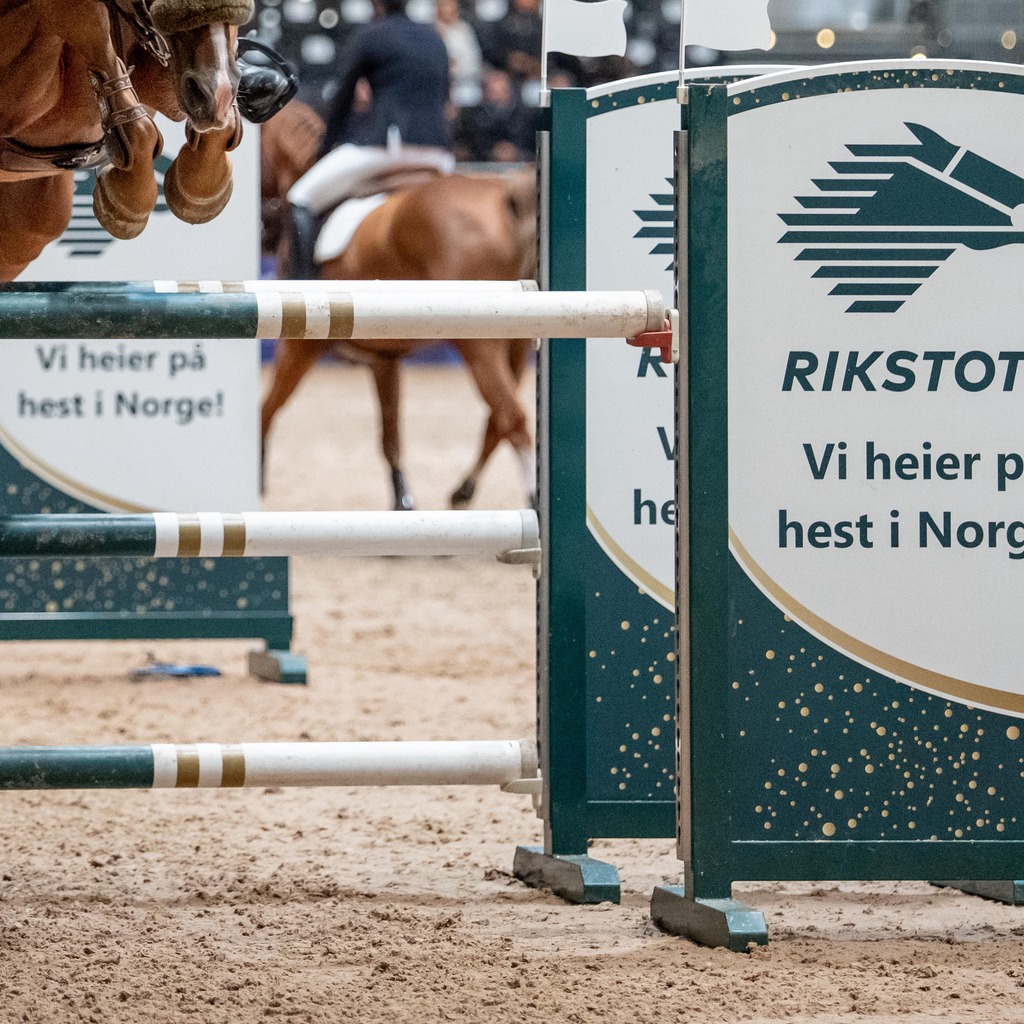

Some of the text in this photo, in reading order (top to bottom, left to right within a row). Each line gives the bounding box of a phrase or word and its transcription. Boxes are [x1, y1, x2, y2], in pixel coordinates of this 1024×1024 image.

[36, 342, 206, 378] Vi heier på
[18, 390, 224, 425] hest i Norge!
[802, 441, 848, 481] Vi
[865, 441, 981, 481] heier
[778, 509, 874, 549] hest
[889, 509, 900, 549] i
